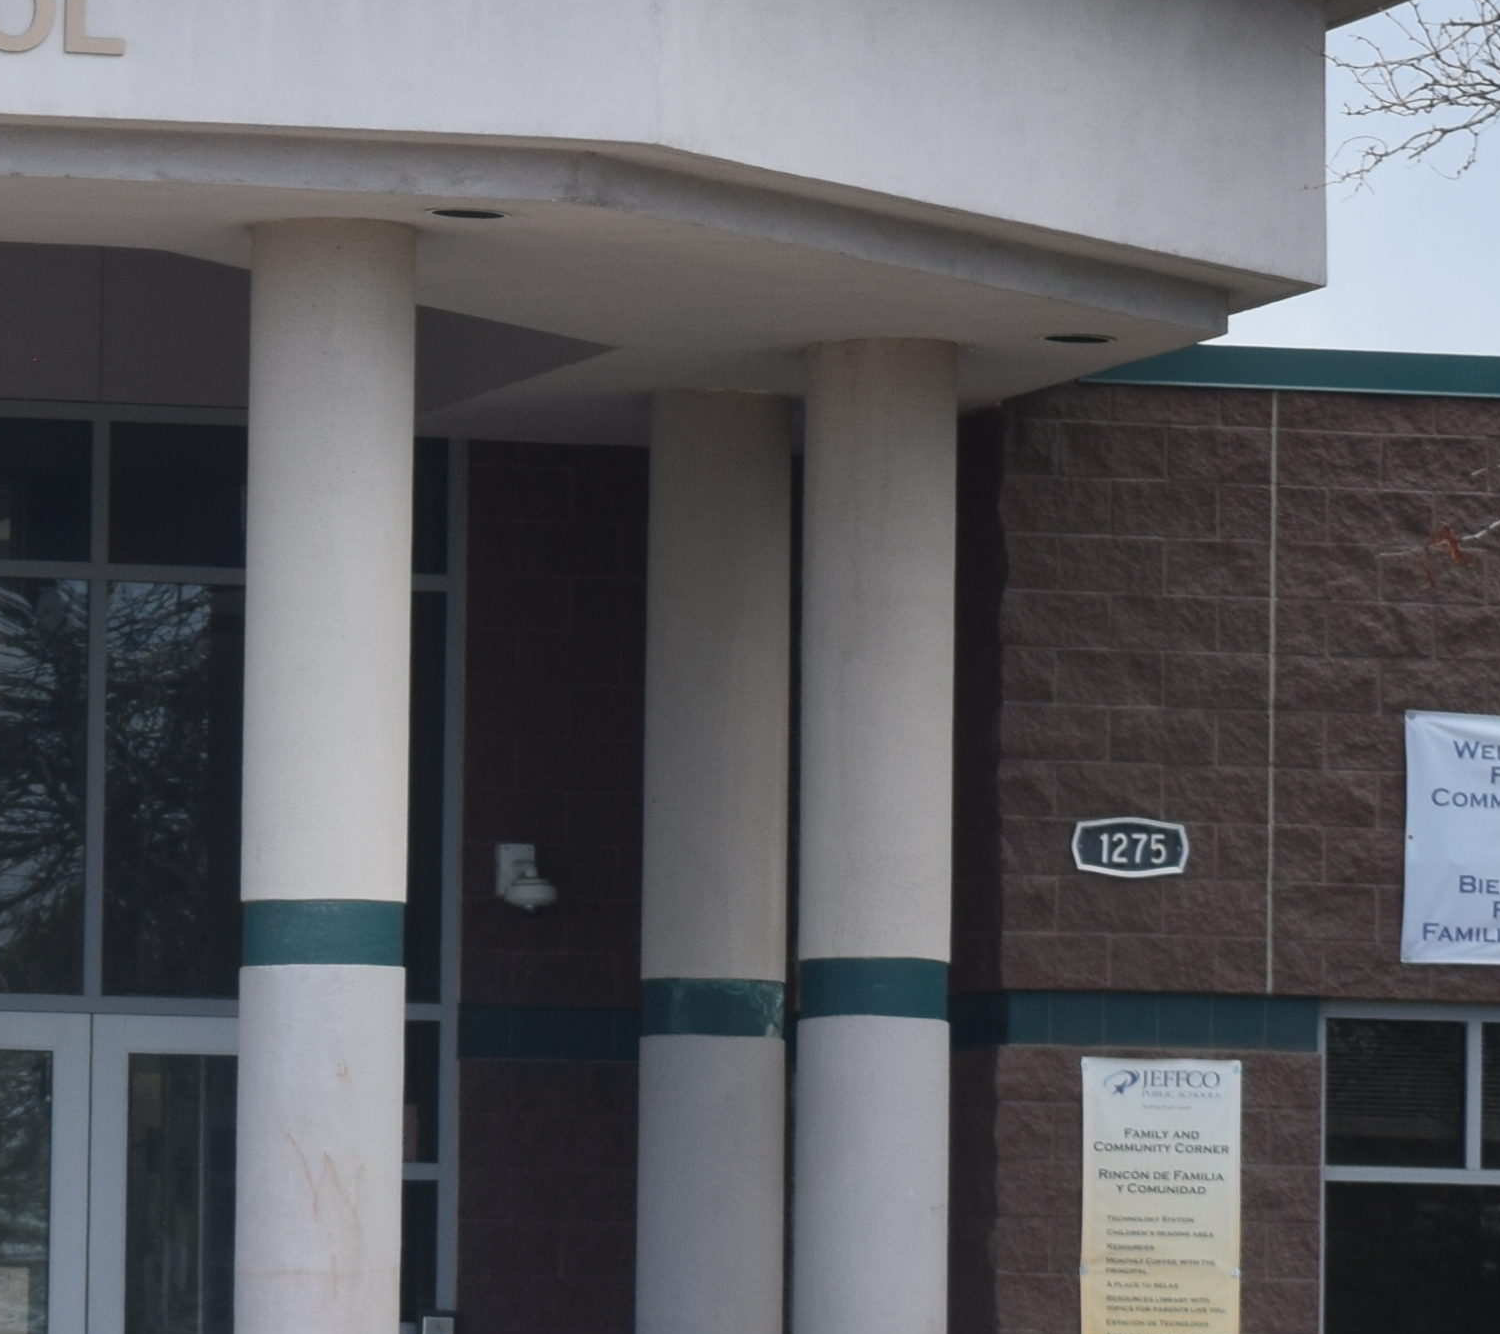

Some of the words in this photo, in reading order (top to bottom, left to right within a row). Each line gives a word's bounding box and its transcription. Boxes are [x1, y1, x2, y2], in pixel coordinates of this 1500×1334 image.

[1099, 832, 1168, 864] 1275
[1142, 1069, 1221, 1089] JEFFCO
[1124, 1128, 1168, 1140] FAMILY
[1172, 1130, 1200, 1140] AND
[1093, 1141, 1171, 1154] COMMUNITY
[1174, 1143, 1230, 1154] CORNER
[1153, 1171, 1169, 1180] DE
[1173, 1170, 1224, 1182] FAMILIA
[1116, 1184, 1125, 1194] Y
[1127, 1183, 1207, 1195] COMUNIDAD
